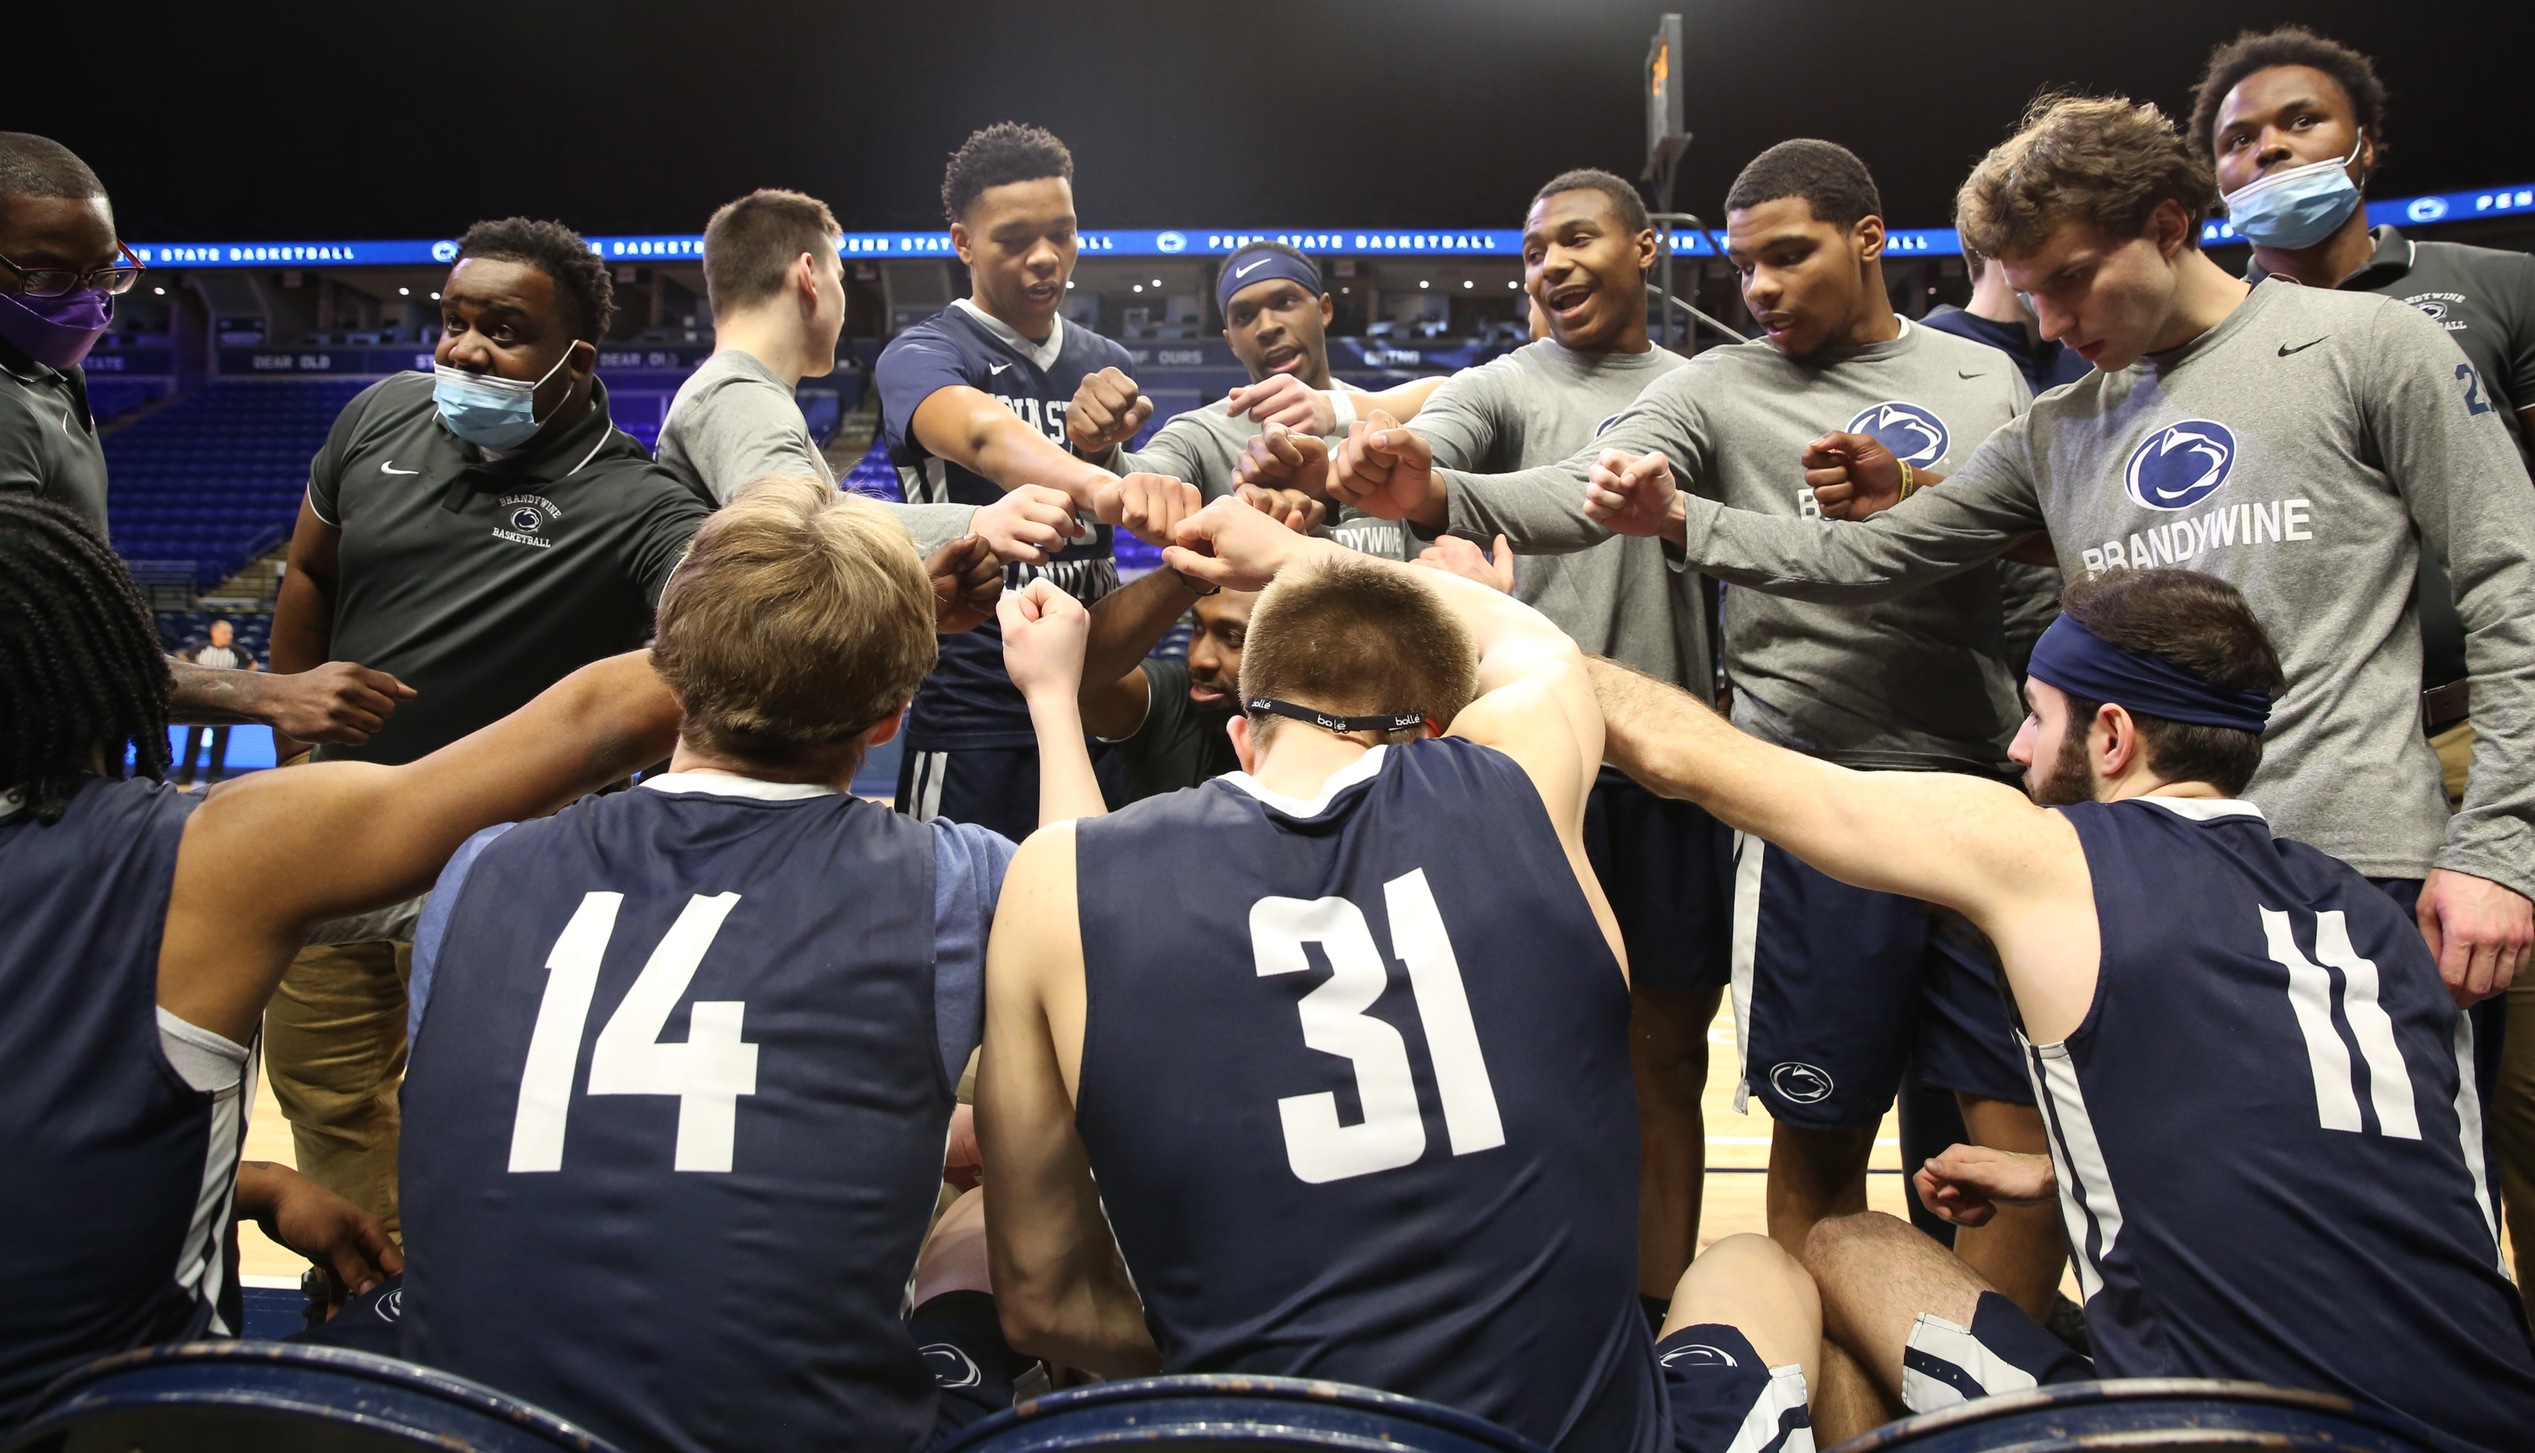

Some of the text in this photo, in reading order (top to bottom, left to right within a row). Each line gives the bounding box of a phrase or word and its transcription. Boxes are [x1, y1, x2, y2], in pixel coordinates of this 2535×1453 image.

[2476, 190, 2534, 211] PEN
[613, 240, 705, 256] BASKETB
[901, 237, 951, 251] STAT
[1277, 235, 1343, 249] STATE
[1355, 234, 1496, 249] BASKETBALL
[160, 248, 220, 262] STATE
[230, 246, 354, 261] BASKETBALL
[252, 354, 331, 369] DEAR OLD
[1158, 350, 1203, 365] OURS
[2454, 363, 2497, 416] 2
[499, 494, 562, 519] BRANDYWINE
[492, 527, 551, 548] BASKETBALL
[1334, 526, 1401, 554] DYWINE
[2082, 499, 2313, 574] BRANDYWINE
[1395, 713, 1420, 726] bollé
[507, 890, 759, 1173] 14
[1248, 866, 1506, 1185] 31
[2258, 903, 2423, 1141] 11
